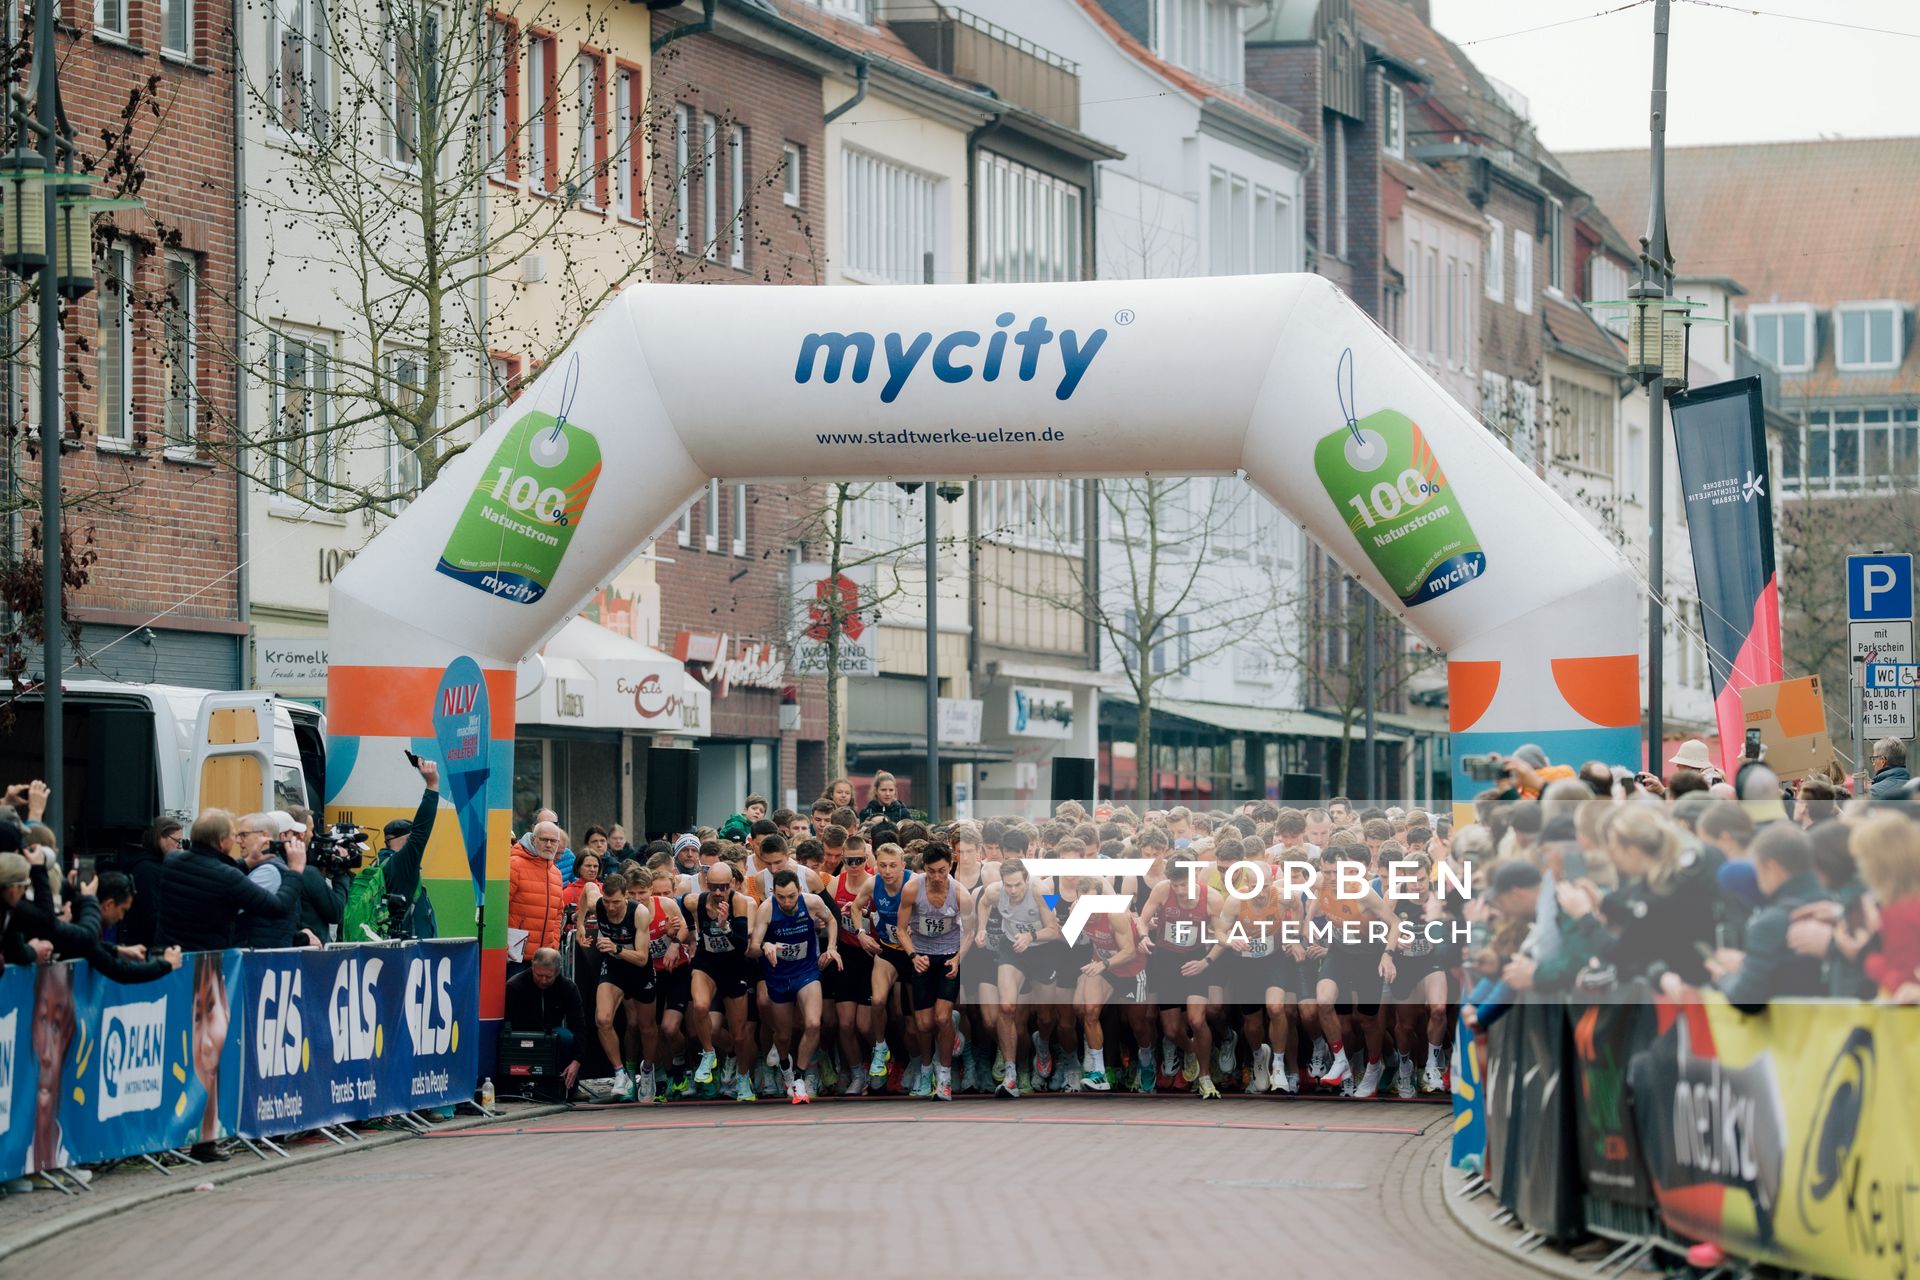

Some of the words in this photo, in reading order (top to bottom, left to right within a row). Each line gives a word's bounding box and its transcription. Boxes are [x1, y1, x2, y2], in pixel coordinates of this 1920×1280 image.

[794, 312, 1108, 403] mycity
[816, 427, 1065, 445] www.stadtwerke-uelzen.de
[1348, 468, 1440, 528] 100%
[480, 505, 559, 546] Naturstrom
[1373, 504, 1450, 548] Naturstrom
[480, 574, 537, 602] mycity
[1429, 559, 1479, 593] mycity
[1863, 565, 1897, 611] P
[1858, 642, 1904, 653] Parkschein
[1874, 629, 1888, 638] mit
[1877, 669, 1894, 683] WC
[442, 683, 480, 717] NLV
[1891, 700, 1897, 710] h
[1899, 714, 1906, 724] h
[782, 949, 801, 957] 927
[128, 1023, 163, 1070] PLAN
[331, 1076, 354, 1104] Parcels
[430, 1067, 449, 1099] People
[274, 1095, 283, 1118] to
[283, 1090, 302, 1123] People
